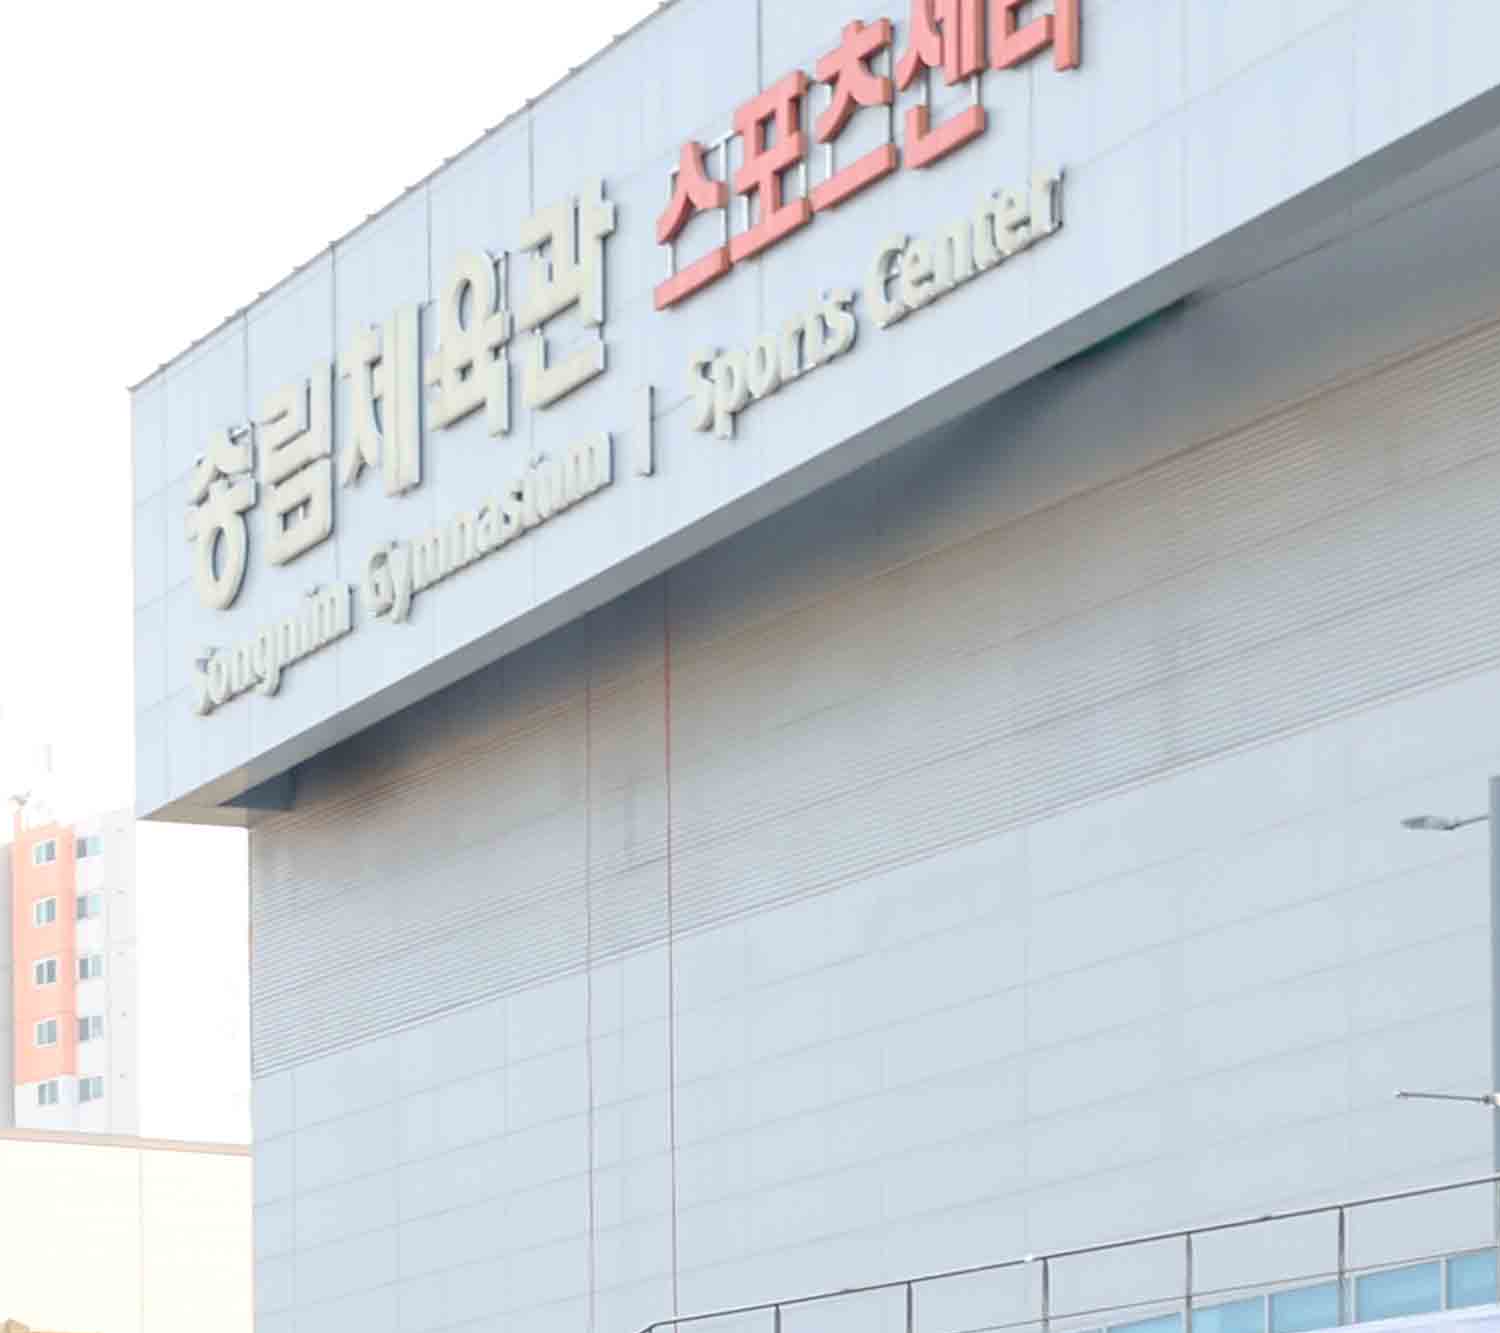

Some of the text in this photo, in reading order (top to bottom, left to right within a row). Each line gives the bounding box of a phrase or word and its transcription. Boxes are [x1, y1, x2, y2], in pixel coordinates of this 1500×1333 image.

[186, 178, 618, 612] 송림체육관
[357, 428, 614, 624] Gymnasium
[686, 284, 860, 441] Sports
[864, 164, 1068, 330] Center
